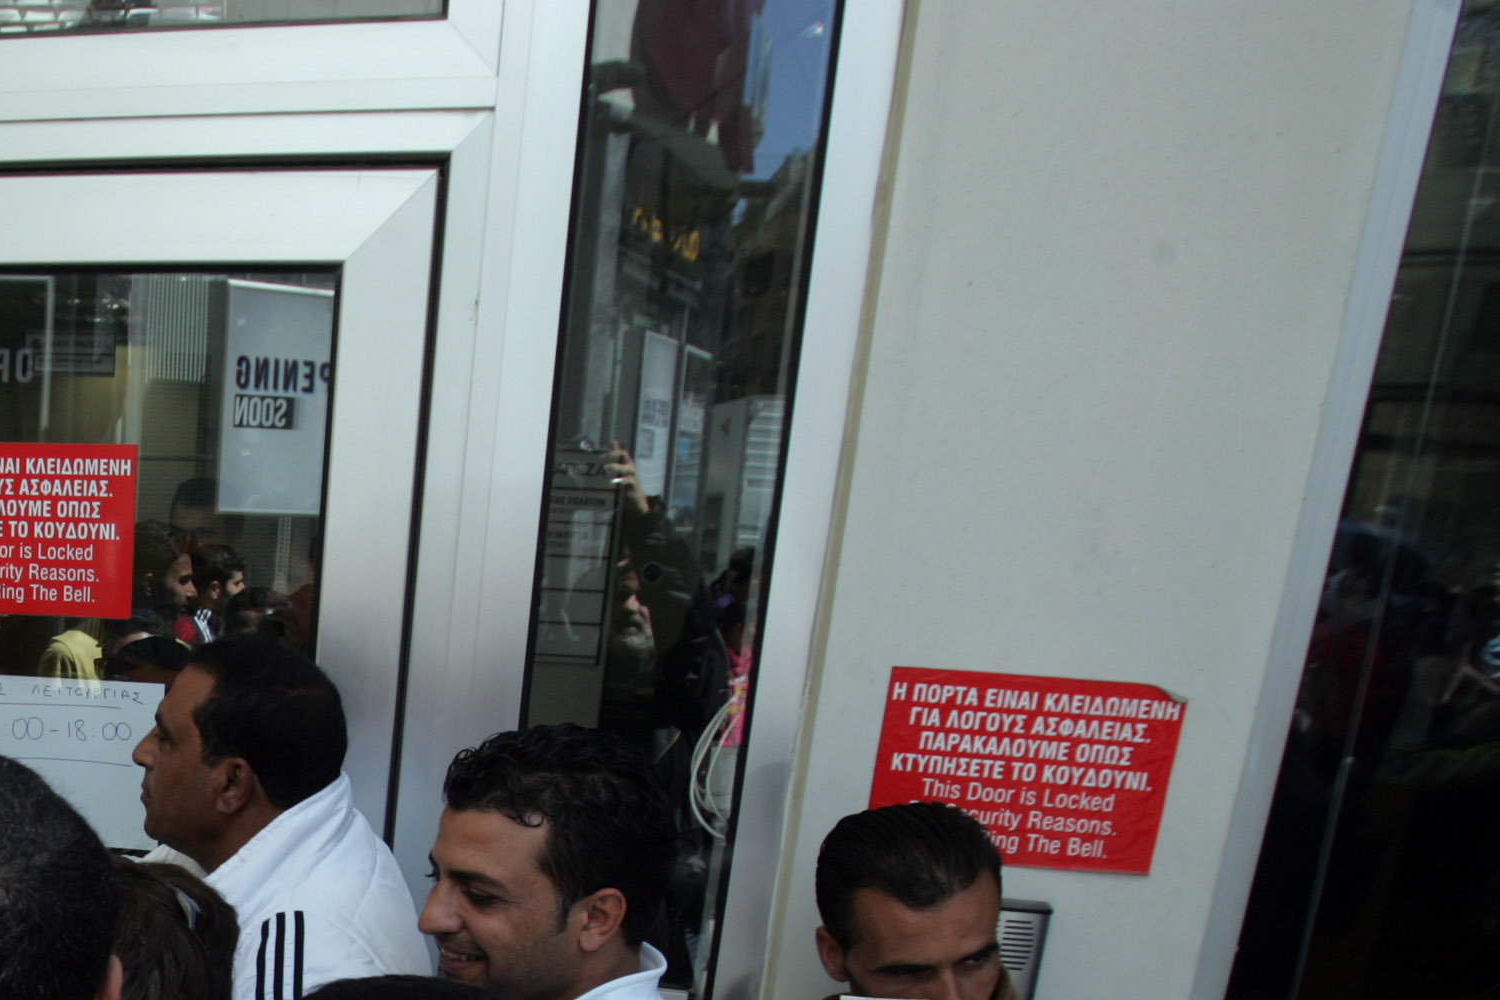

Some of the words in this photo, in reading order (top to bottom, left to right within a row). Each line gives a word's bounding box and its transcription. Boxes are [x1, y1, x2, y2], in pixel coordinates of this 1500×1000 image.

[26, 458, 131, 475] ΚΛΕΙΔΩΜΕΝΗ
[19, 478, 113, 496] ΑΣΦΑΛΕΙΑΣ.
[57, 501, 101, 518] ΟΠΩΣ
[9, 521, 28, 537] ΤΟ
[34, 522, 120, 540] ΚΟΥΔΟΥΝΙ.
[20, 543, 31, 559] is
[38, 543, 93, 560] Locked
[29, 564, 99, 582] Reasons.
[30, 585, 57, 600] The
[63, 586, 95, 602] Bell.
[32, 684, 144, 705] ΛΕΙΤΟΥΡΓΙΑΣ
[892, 682, 907, 701] Η
[913, 684, 978, 706] ΠΟΡΤΑ
[985, 689, 1038, 710] ΕΙΝΑΙ
[1044, 693, 1180, 721] ΚΛΕΙΔΩΜΕΝΗ
[909, 708, 941, 727] ΓΙΑ
[946, 710, 1026, 733] ΛΟΓΟΥΣ
[1030, 717, 1151, 743] ΑΣΦΑΛΕΙΑΣ.
[919, 732, 1069, 761] ΠΑΡΑΚΑΛΟΥΜΕ
[1075, 743, 1134, 766] ΟΠΩΣ
[891, 753, 1004, 779] ΚΤΥΠΗΣΕΤΕ
[1011, 762, 1036, 782] ΤΟ
[1042, 765, 1152, 791] ΚΟΥΔΟΥΝΙ.
[922, 779, 960, 799] This
[967, 782, 1016, 804] Door
[1020, 787, 1037, 805] is
[1043, 789, 1116, 812] Locked
[946, 803, 1022, 829] curity
[1028, 811, 1117, 836] Reasons.
[982, 831, 1018, 855] ing
[1027, 833, 1060, 855] The
[1067, 838, 1107, 859] Bell.
